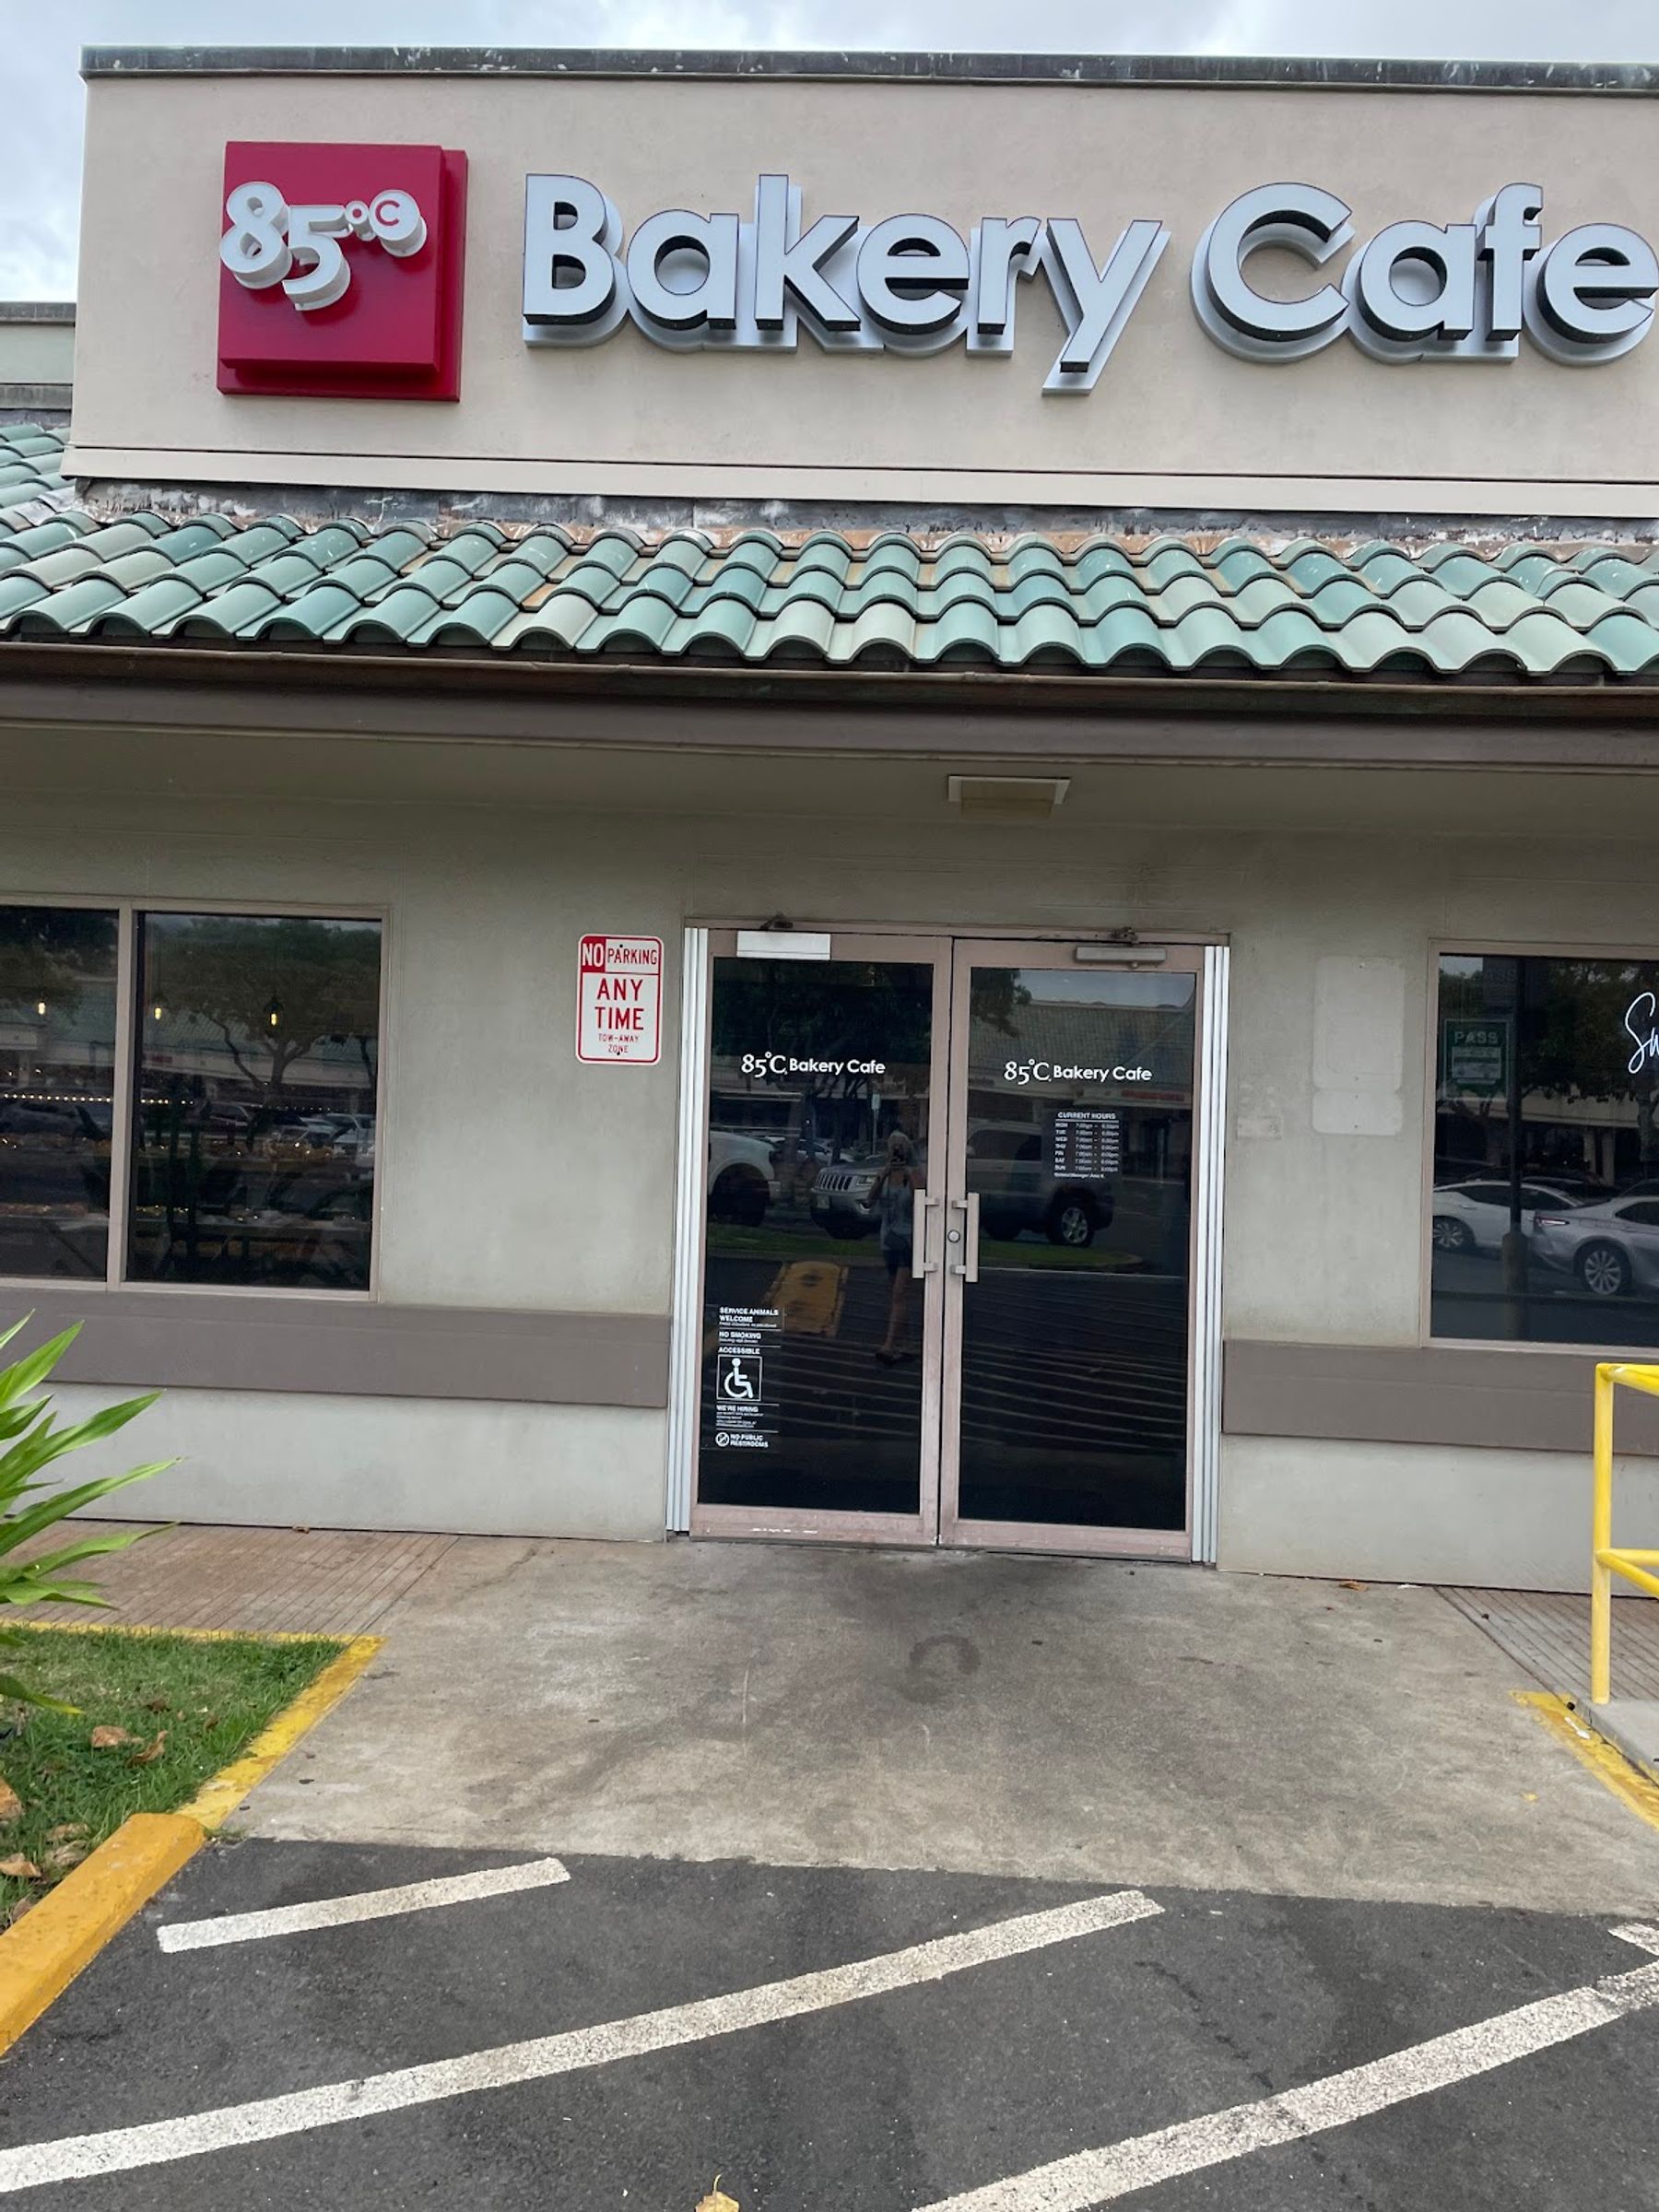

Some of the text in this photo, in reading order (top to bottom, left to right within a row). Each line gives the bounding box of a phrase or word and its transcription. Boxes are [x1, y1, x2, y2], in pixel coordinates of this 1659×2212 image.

[523, 173, 1659, 382] Bakery Cafe
[582, 943, 658, 967] NO PARKING
[597, 978, 643, 1001] ANY
[594, 1006, 644, 1030] TIME
[598, 1033, 640, 1042] TOW-AWAY
[1454, 1030, 1499, 1045] PASS
[607, 1044, 629, 1053] ZONE
[789, 1058, 844, 1075] Bakery
[846, 1059, 886, 1074] Cafe
[1053, 1065, 1109, 1082] Bakery
[1112, 1066, 1152, 1080] Cafe
[719, 1306, 779, 1316] SERVICE ANIMALS
[719, 1314, 753, 1323] WELCOME
[718, 1347, 760, 1355] ACCESSIBLE
[730, 1440, 769, 1448] RESTROOMS
